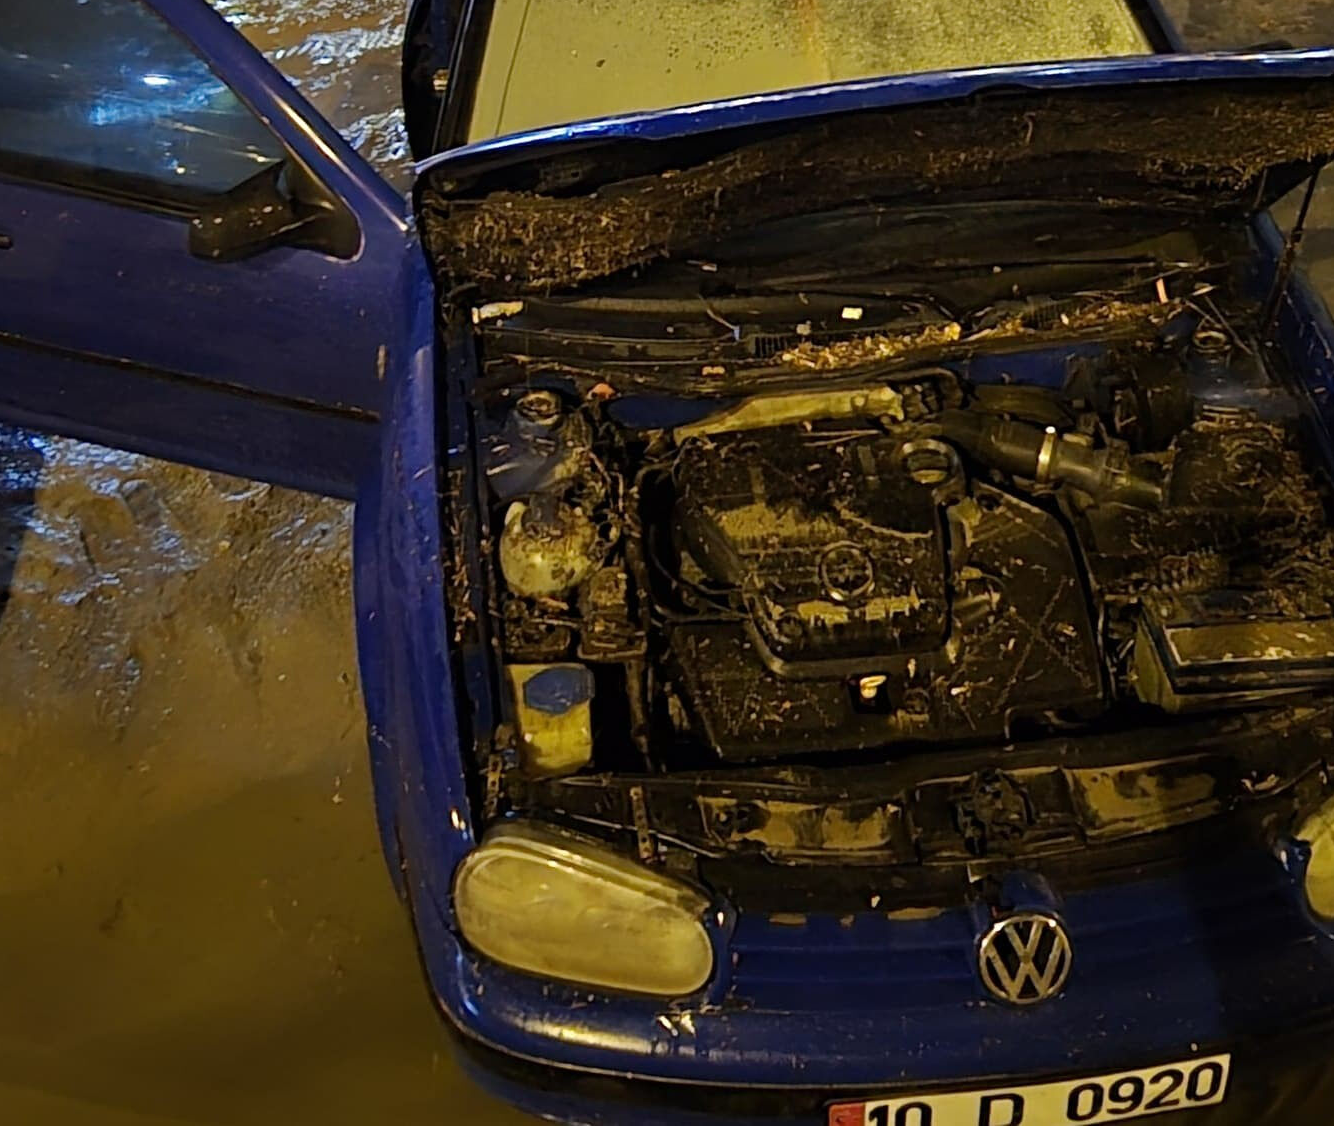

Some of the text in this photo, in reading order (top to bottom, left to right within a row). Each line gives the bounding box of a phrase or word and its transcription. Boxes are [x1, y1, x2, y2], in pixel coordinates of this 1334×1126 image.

[868, 1061, 1224, 1126] 10 D 0920
